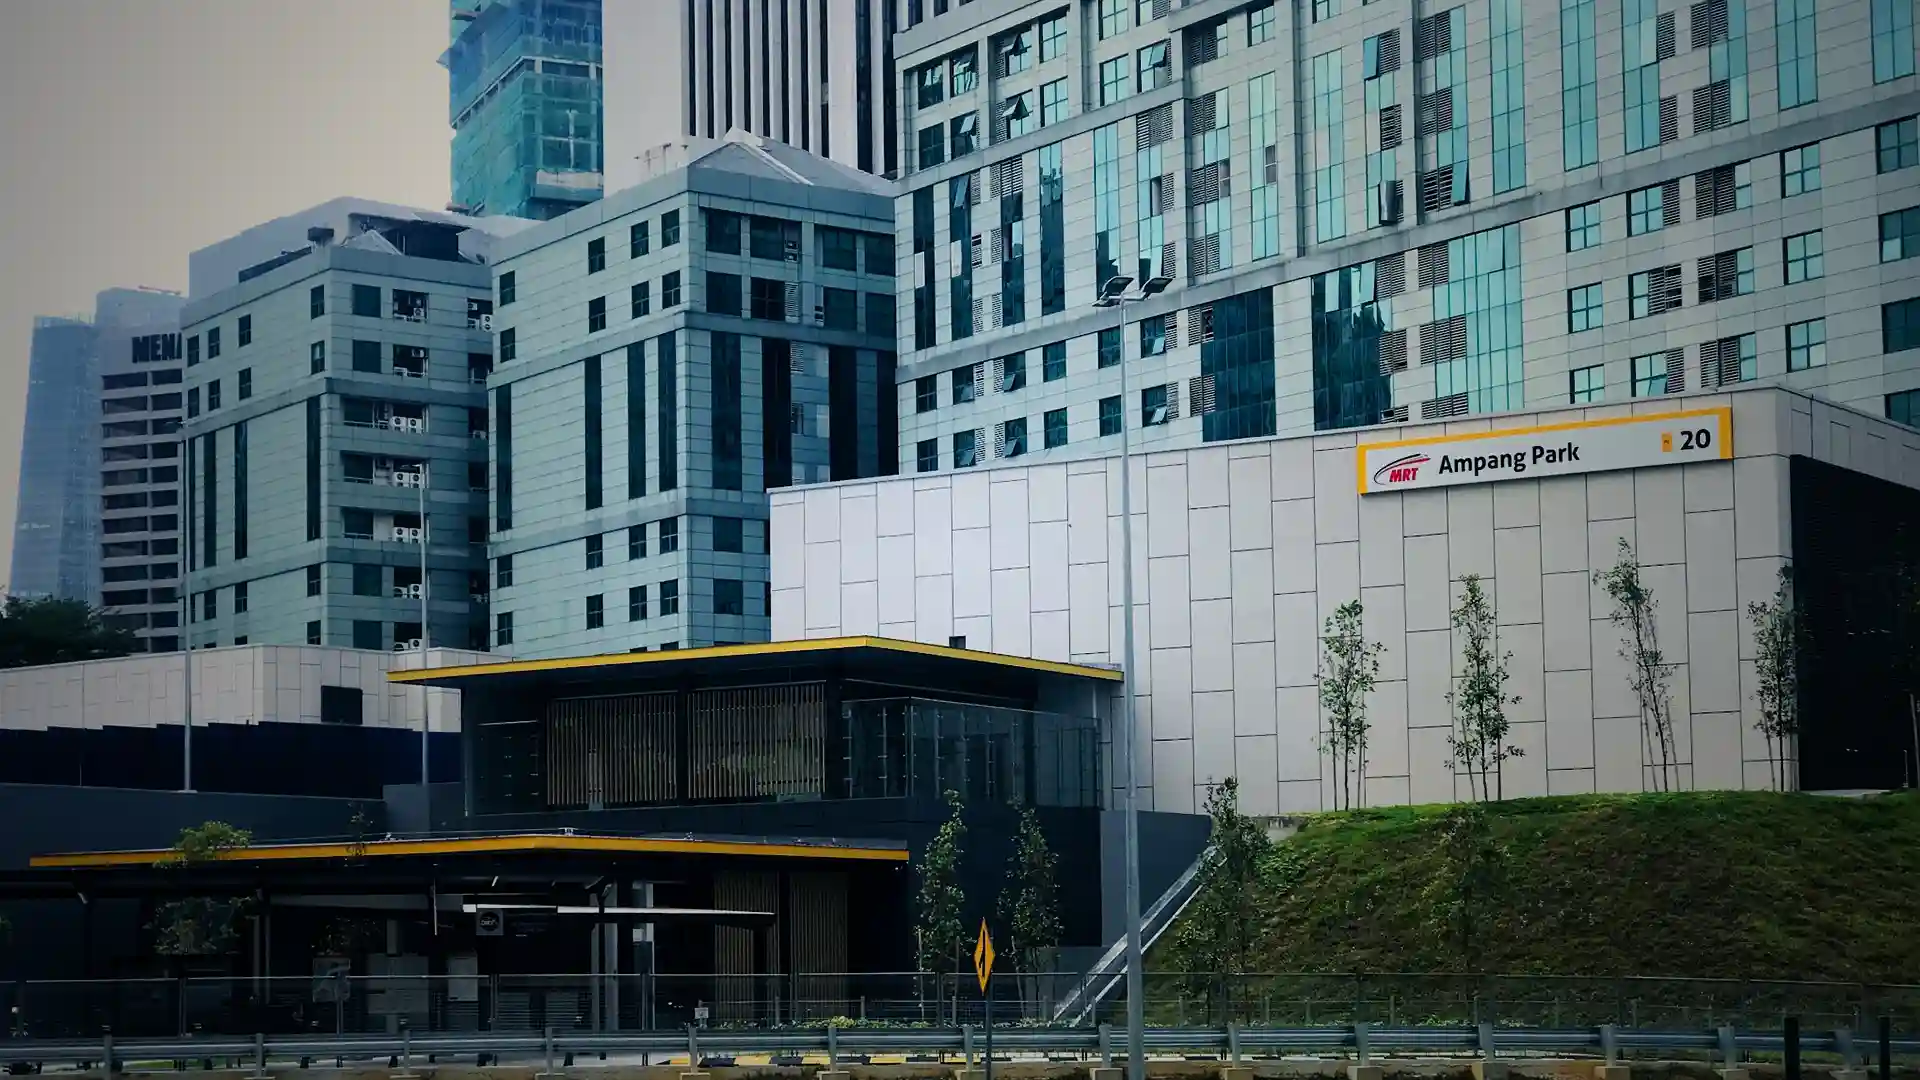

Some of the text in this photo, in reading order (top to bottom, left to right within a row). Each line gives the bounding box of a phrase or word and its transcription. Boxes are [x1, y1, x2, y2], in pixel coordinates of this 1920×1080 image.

[1680, 428, 1711, 450] 20
[1438, 442, 1580, 476] Ampang Park
[1389, 467, 1419, 483] MRT
